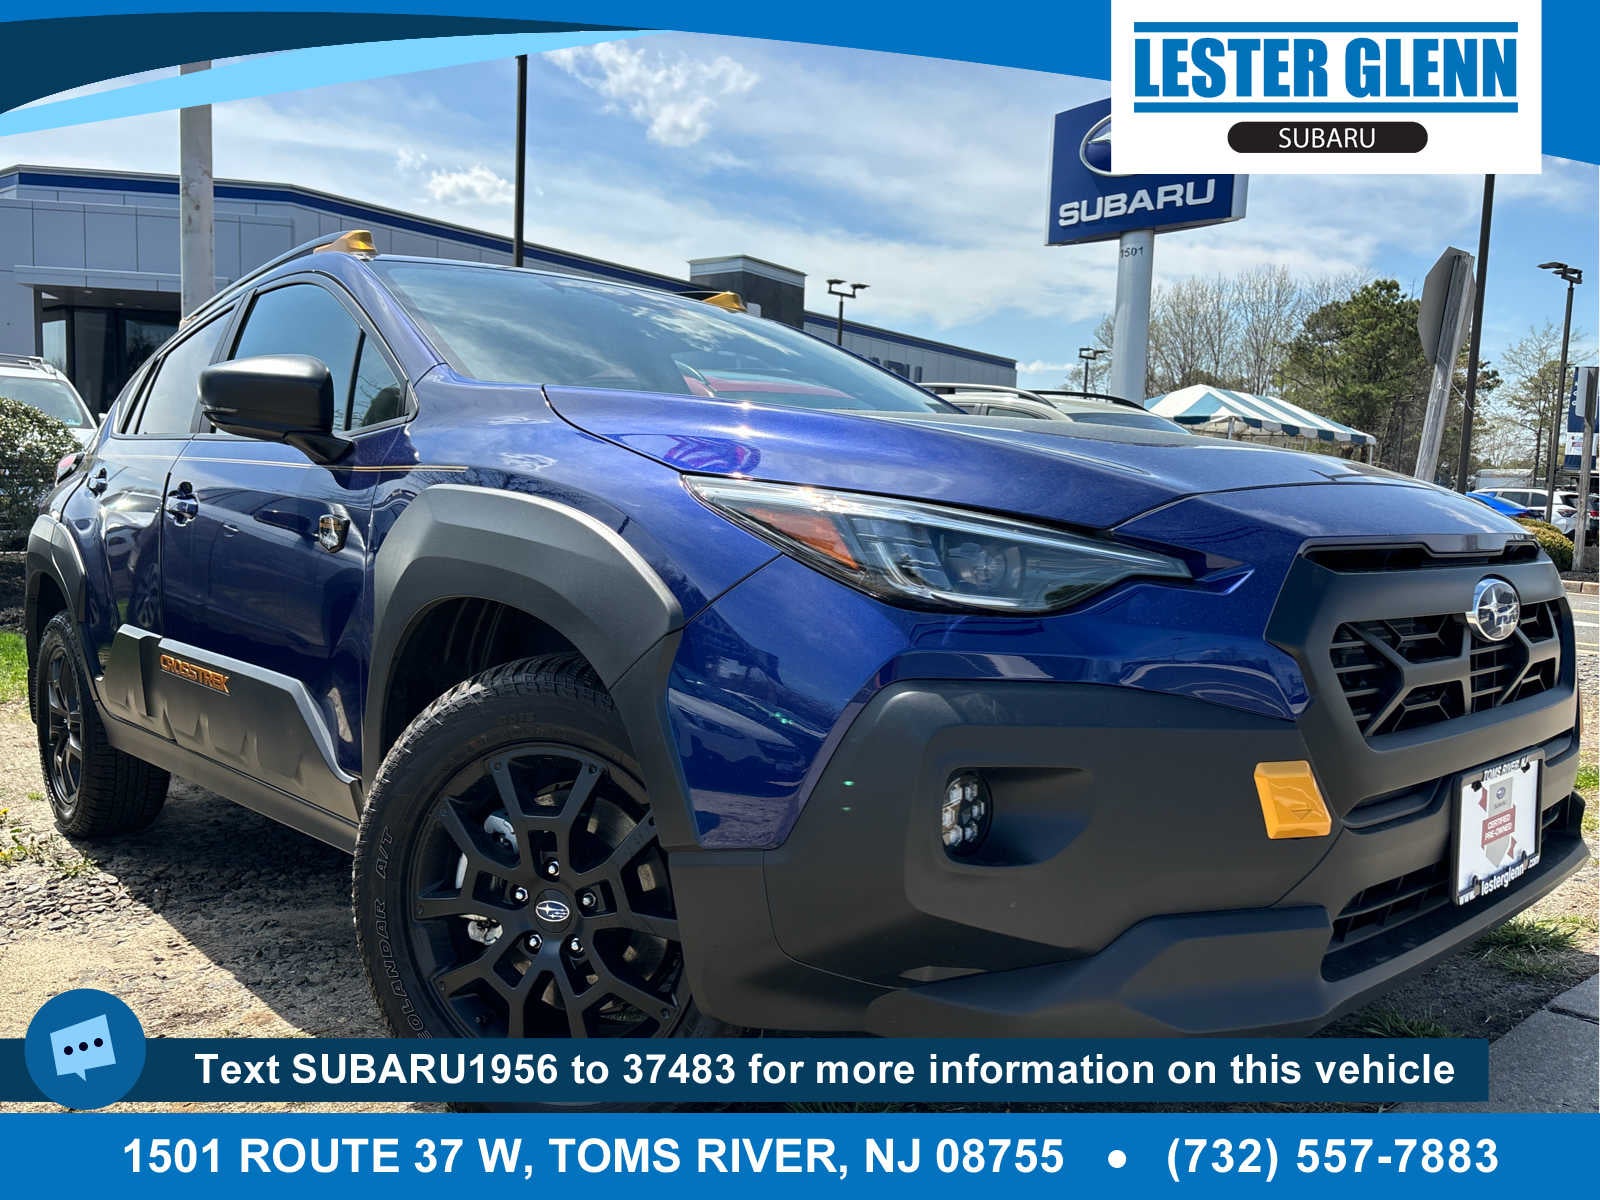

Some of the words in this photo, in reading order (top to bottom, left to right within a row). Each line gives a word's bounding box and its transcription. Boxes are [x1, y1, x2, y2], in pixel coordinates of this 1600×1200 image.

[1058, 179, 1216, 227] SUBARU
[1119, 246, 1144, 259] 1501
[160, 654, 231, 694] CROSSTREK
[375, 824, 393, 880] A/T
